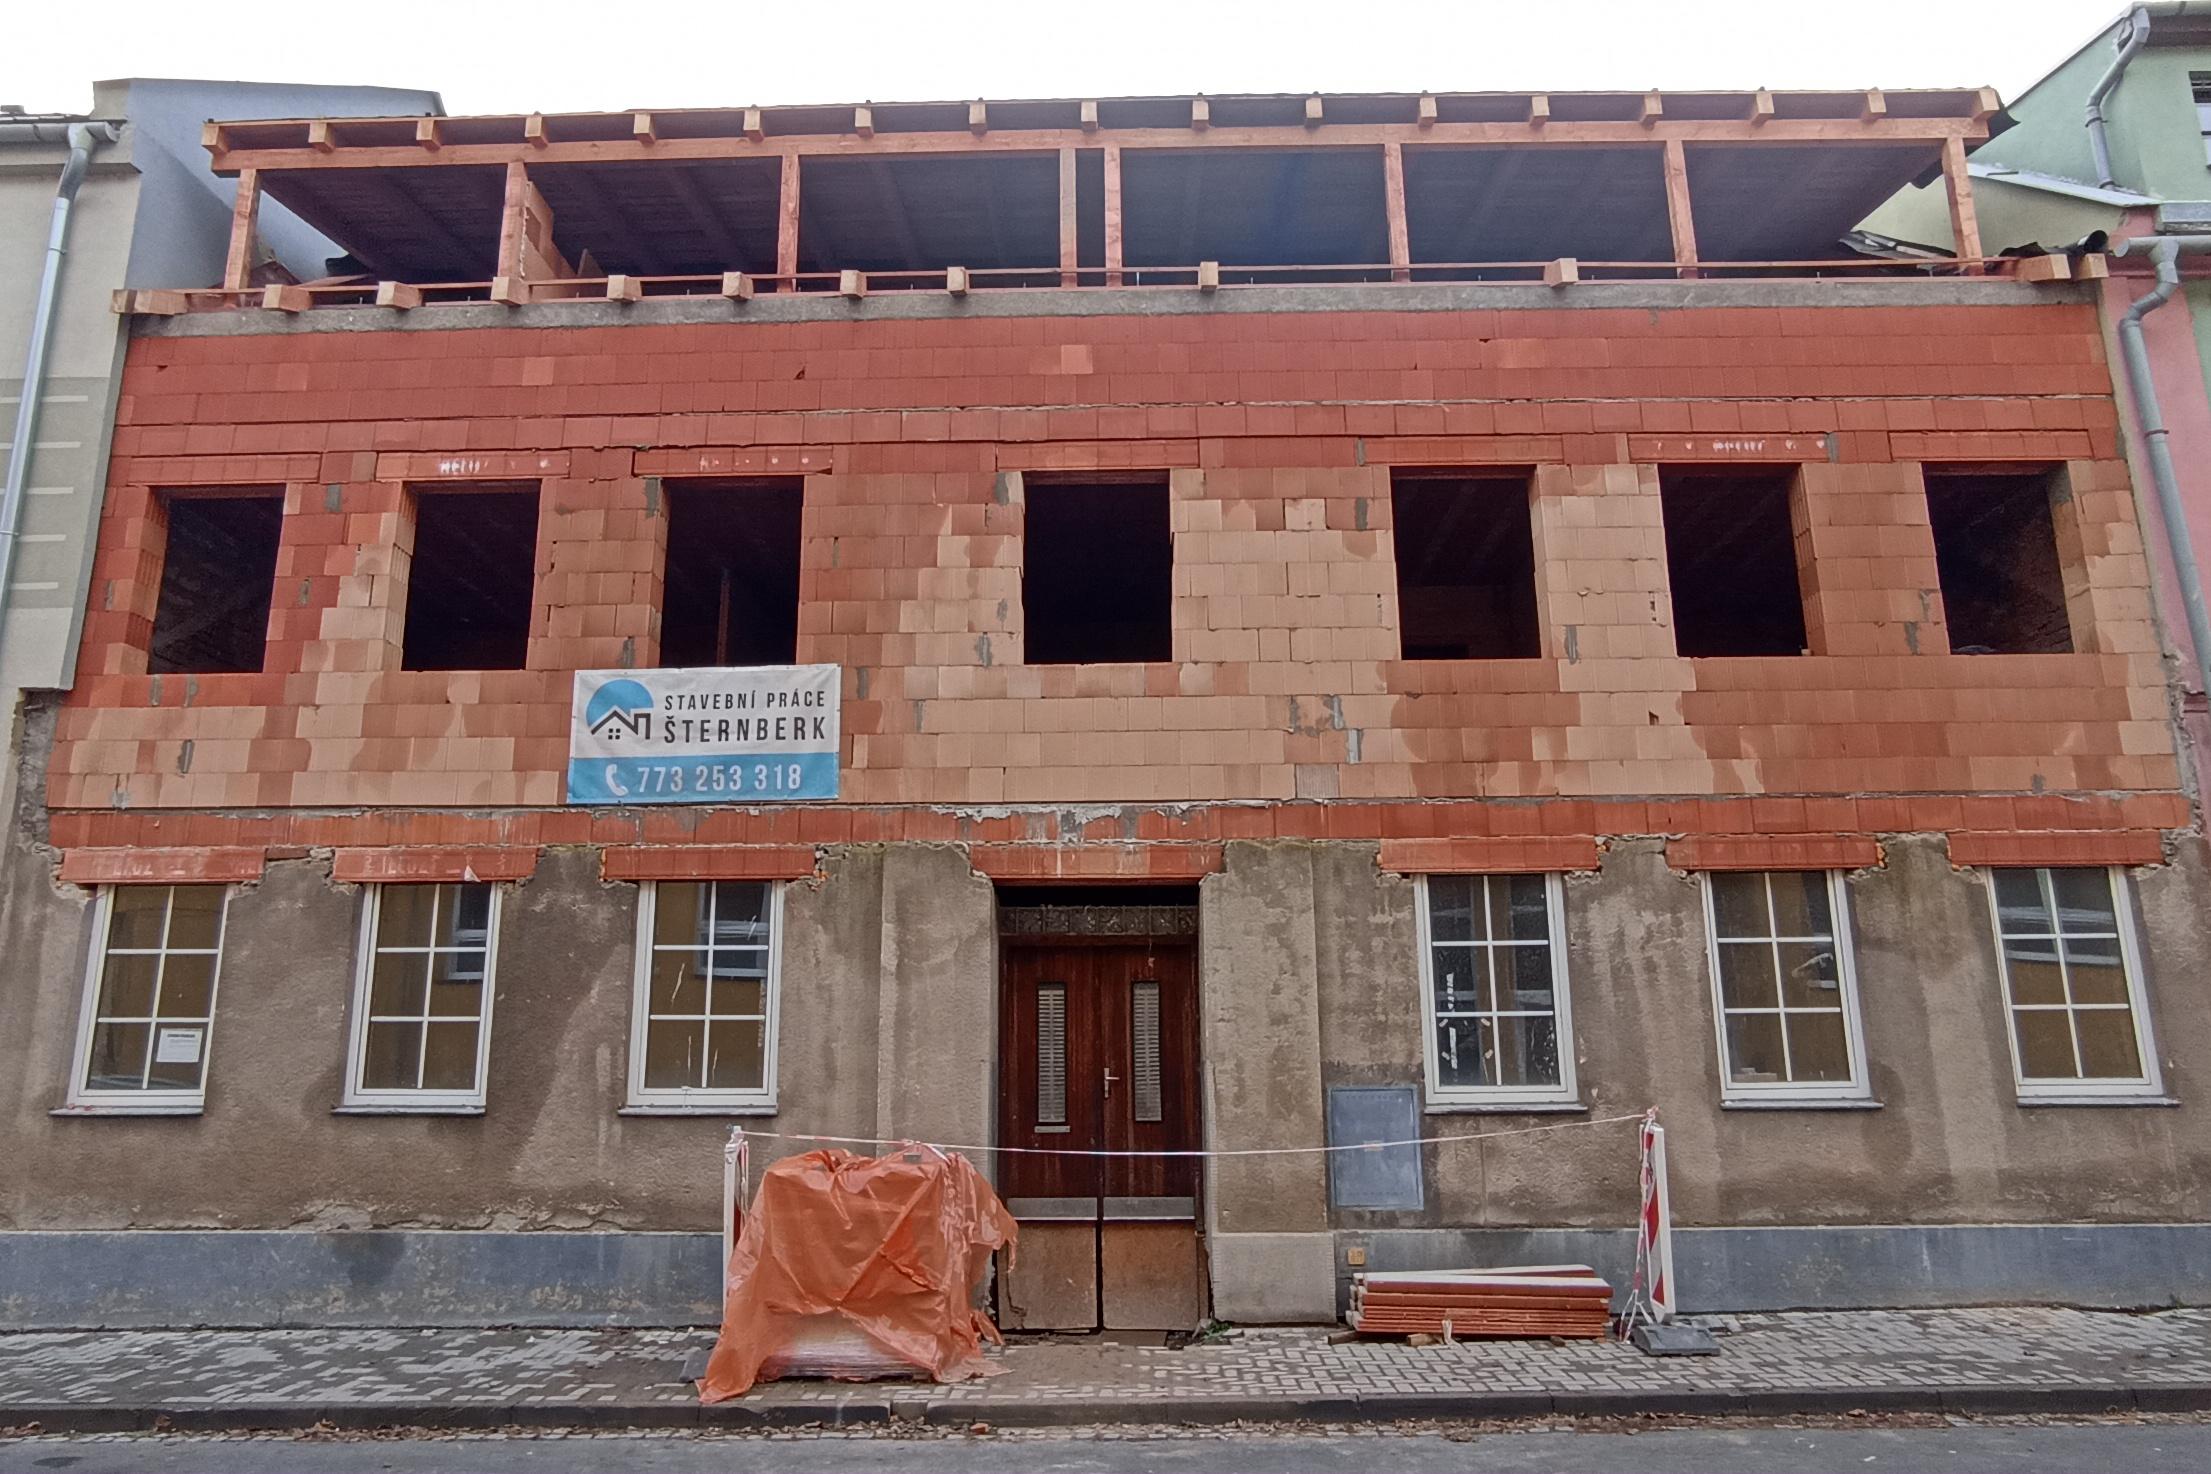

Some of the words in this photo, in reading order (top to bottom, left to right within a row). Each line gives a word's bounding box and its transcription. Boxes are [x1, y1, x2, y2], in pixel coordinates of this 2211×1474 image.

[664, 690, 756, 711] STAVEBNÍ
[766, 688, 825, 708] PRÁCE
[664, 715, 826, 744] ŠTERNBERK
[637, 765, 684, 793] 773
[696, 765, 742, 791] 253
[754, 764, 802, 790] 318
